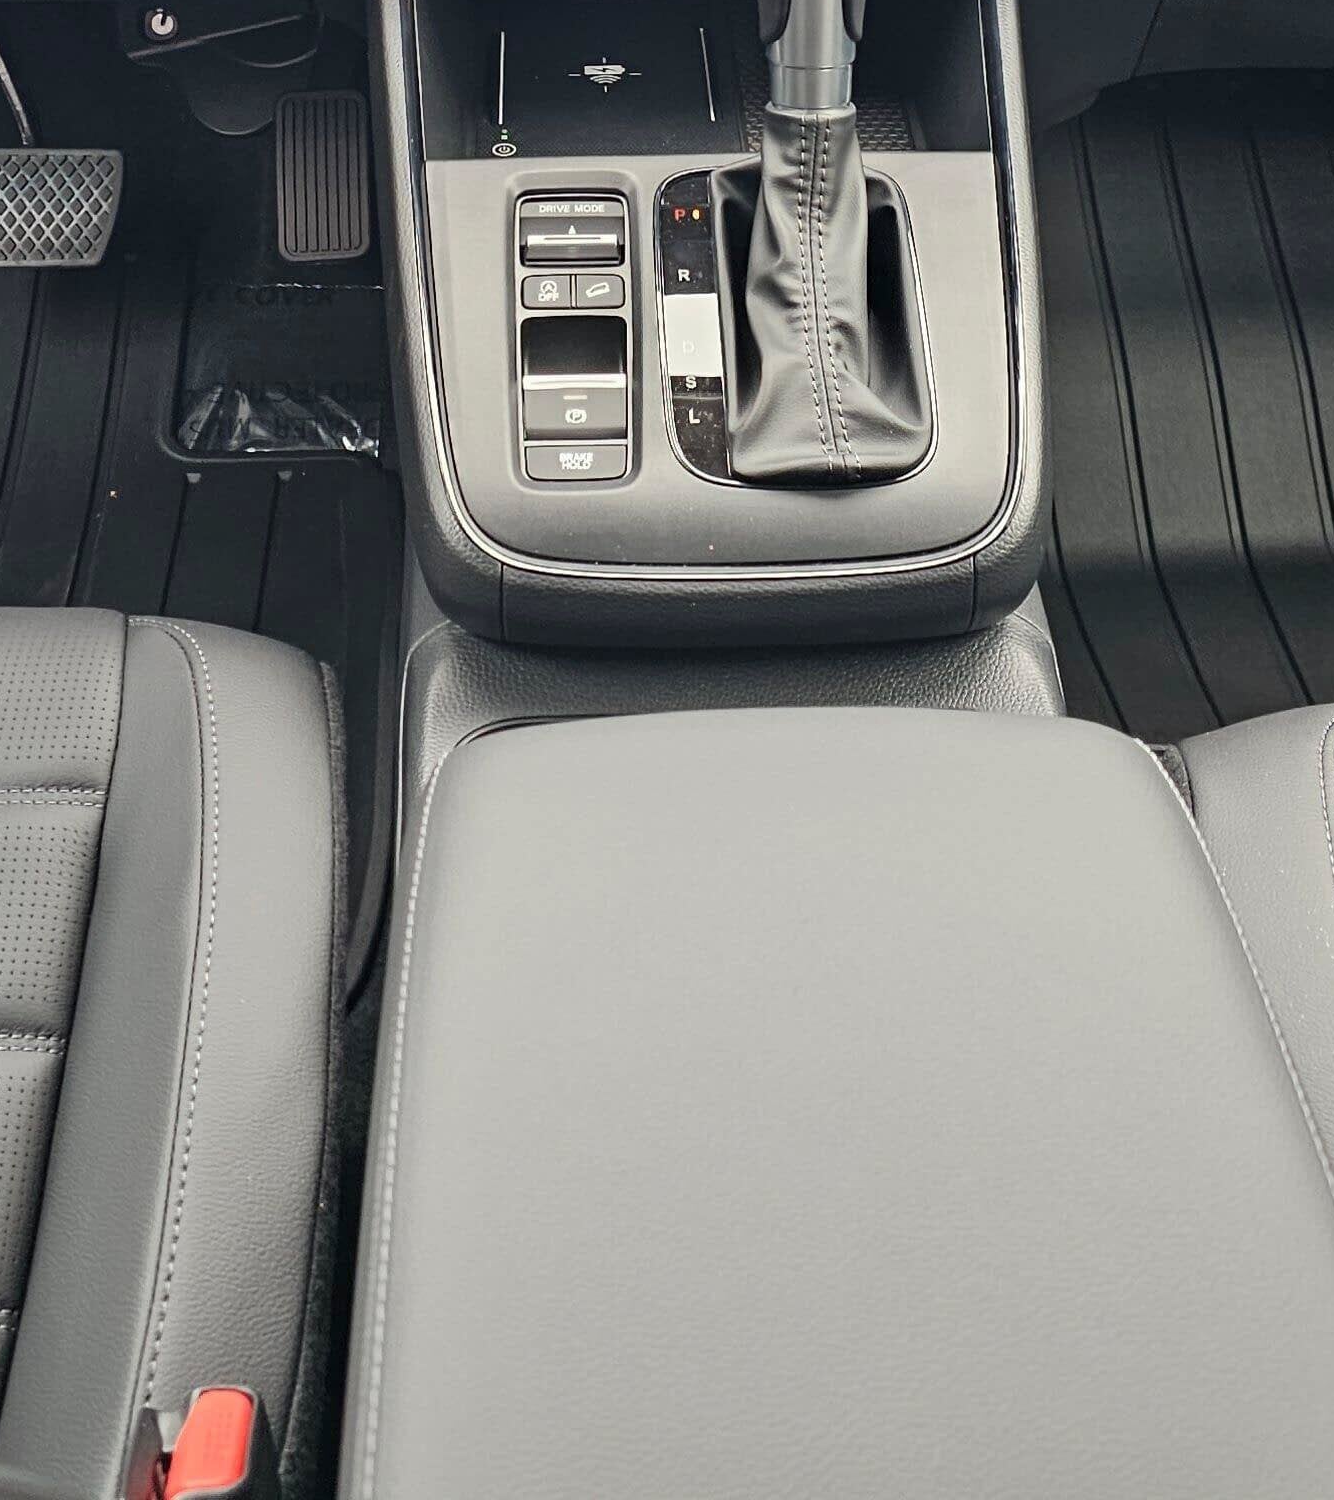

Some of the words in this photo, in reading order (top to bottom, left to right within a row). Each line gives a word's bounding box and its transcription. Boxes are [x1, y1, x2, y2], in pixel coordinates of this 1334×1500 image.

[539, 204, 570, 213] DRIVE
[574, 204, 605, 213] MODE
[674, 209, 685, 221] P
[677, 269, 690, 282] R
[537, 292, 559, 302] OFF
[685, 375, 697, 389] S
[688, 408, 701, 424] L
[559, 452, 594, 462] BRAKE
[561, 460, 592, 470] HOLD
